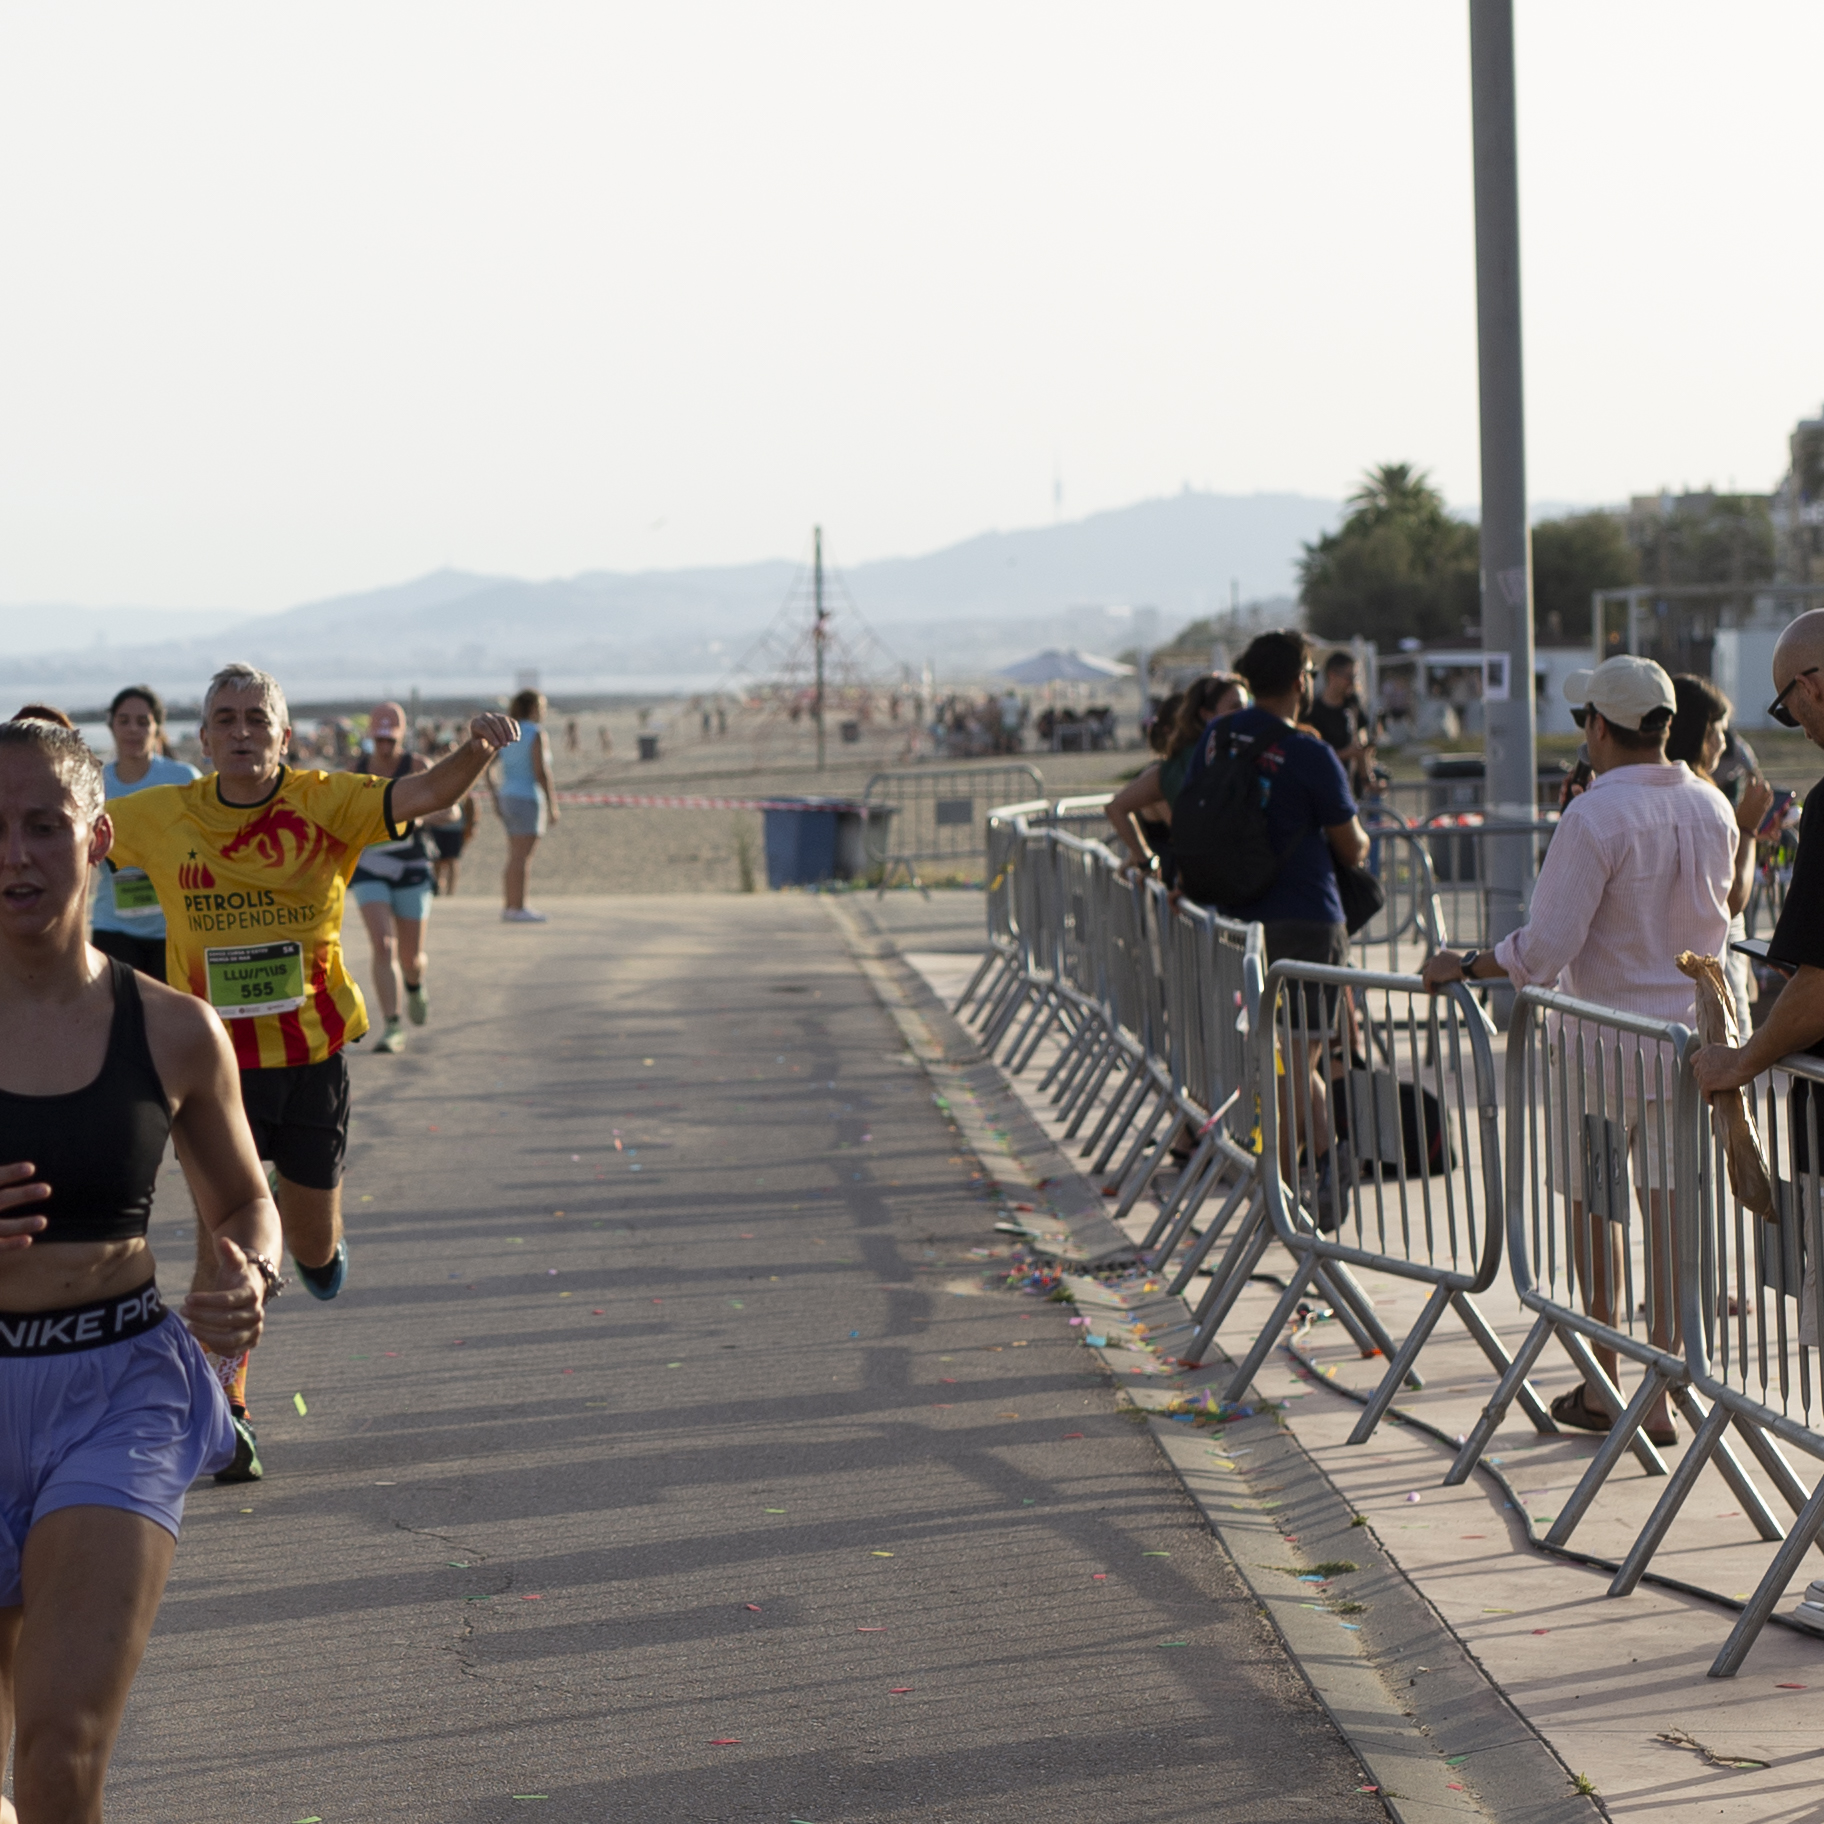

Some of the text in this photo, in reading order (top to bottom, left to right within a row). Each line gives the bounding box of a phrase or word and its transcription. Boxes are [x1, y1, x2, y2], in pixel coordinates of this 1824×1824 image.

[184, 890, 275, 912] PETROLIS
[188, 904, 316, 932] INDEPENDENTS
[240, 981, 274, 999] 555
[115, 1286, 161, 1333] PR
